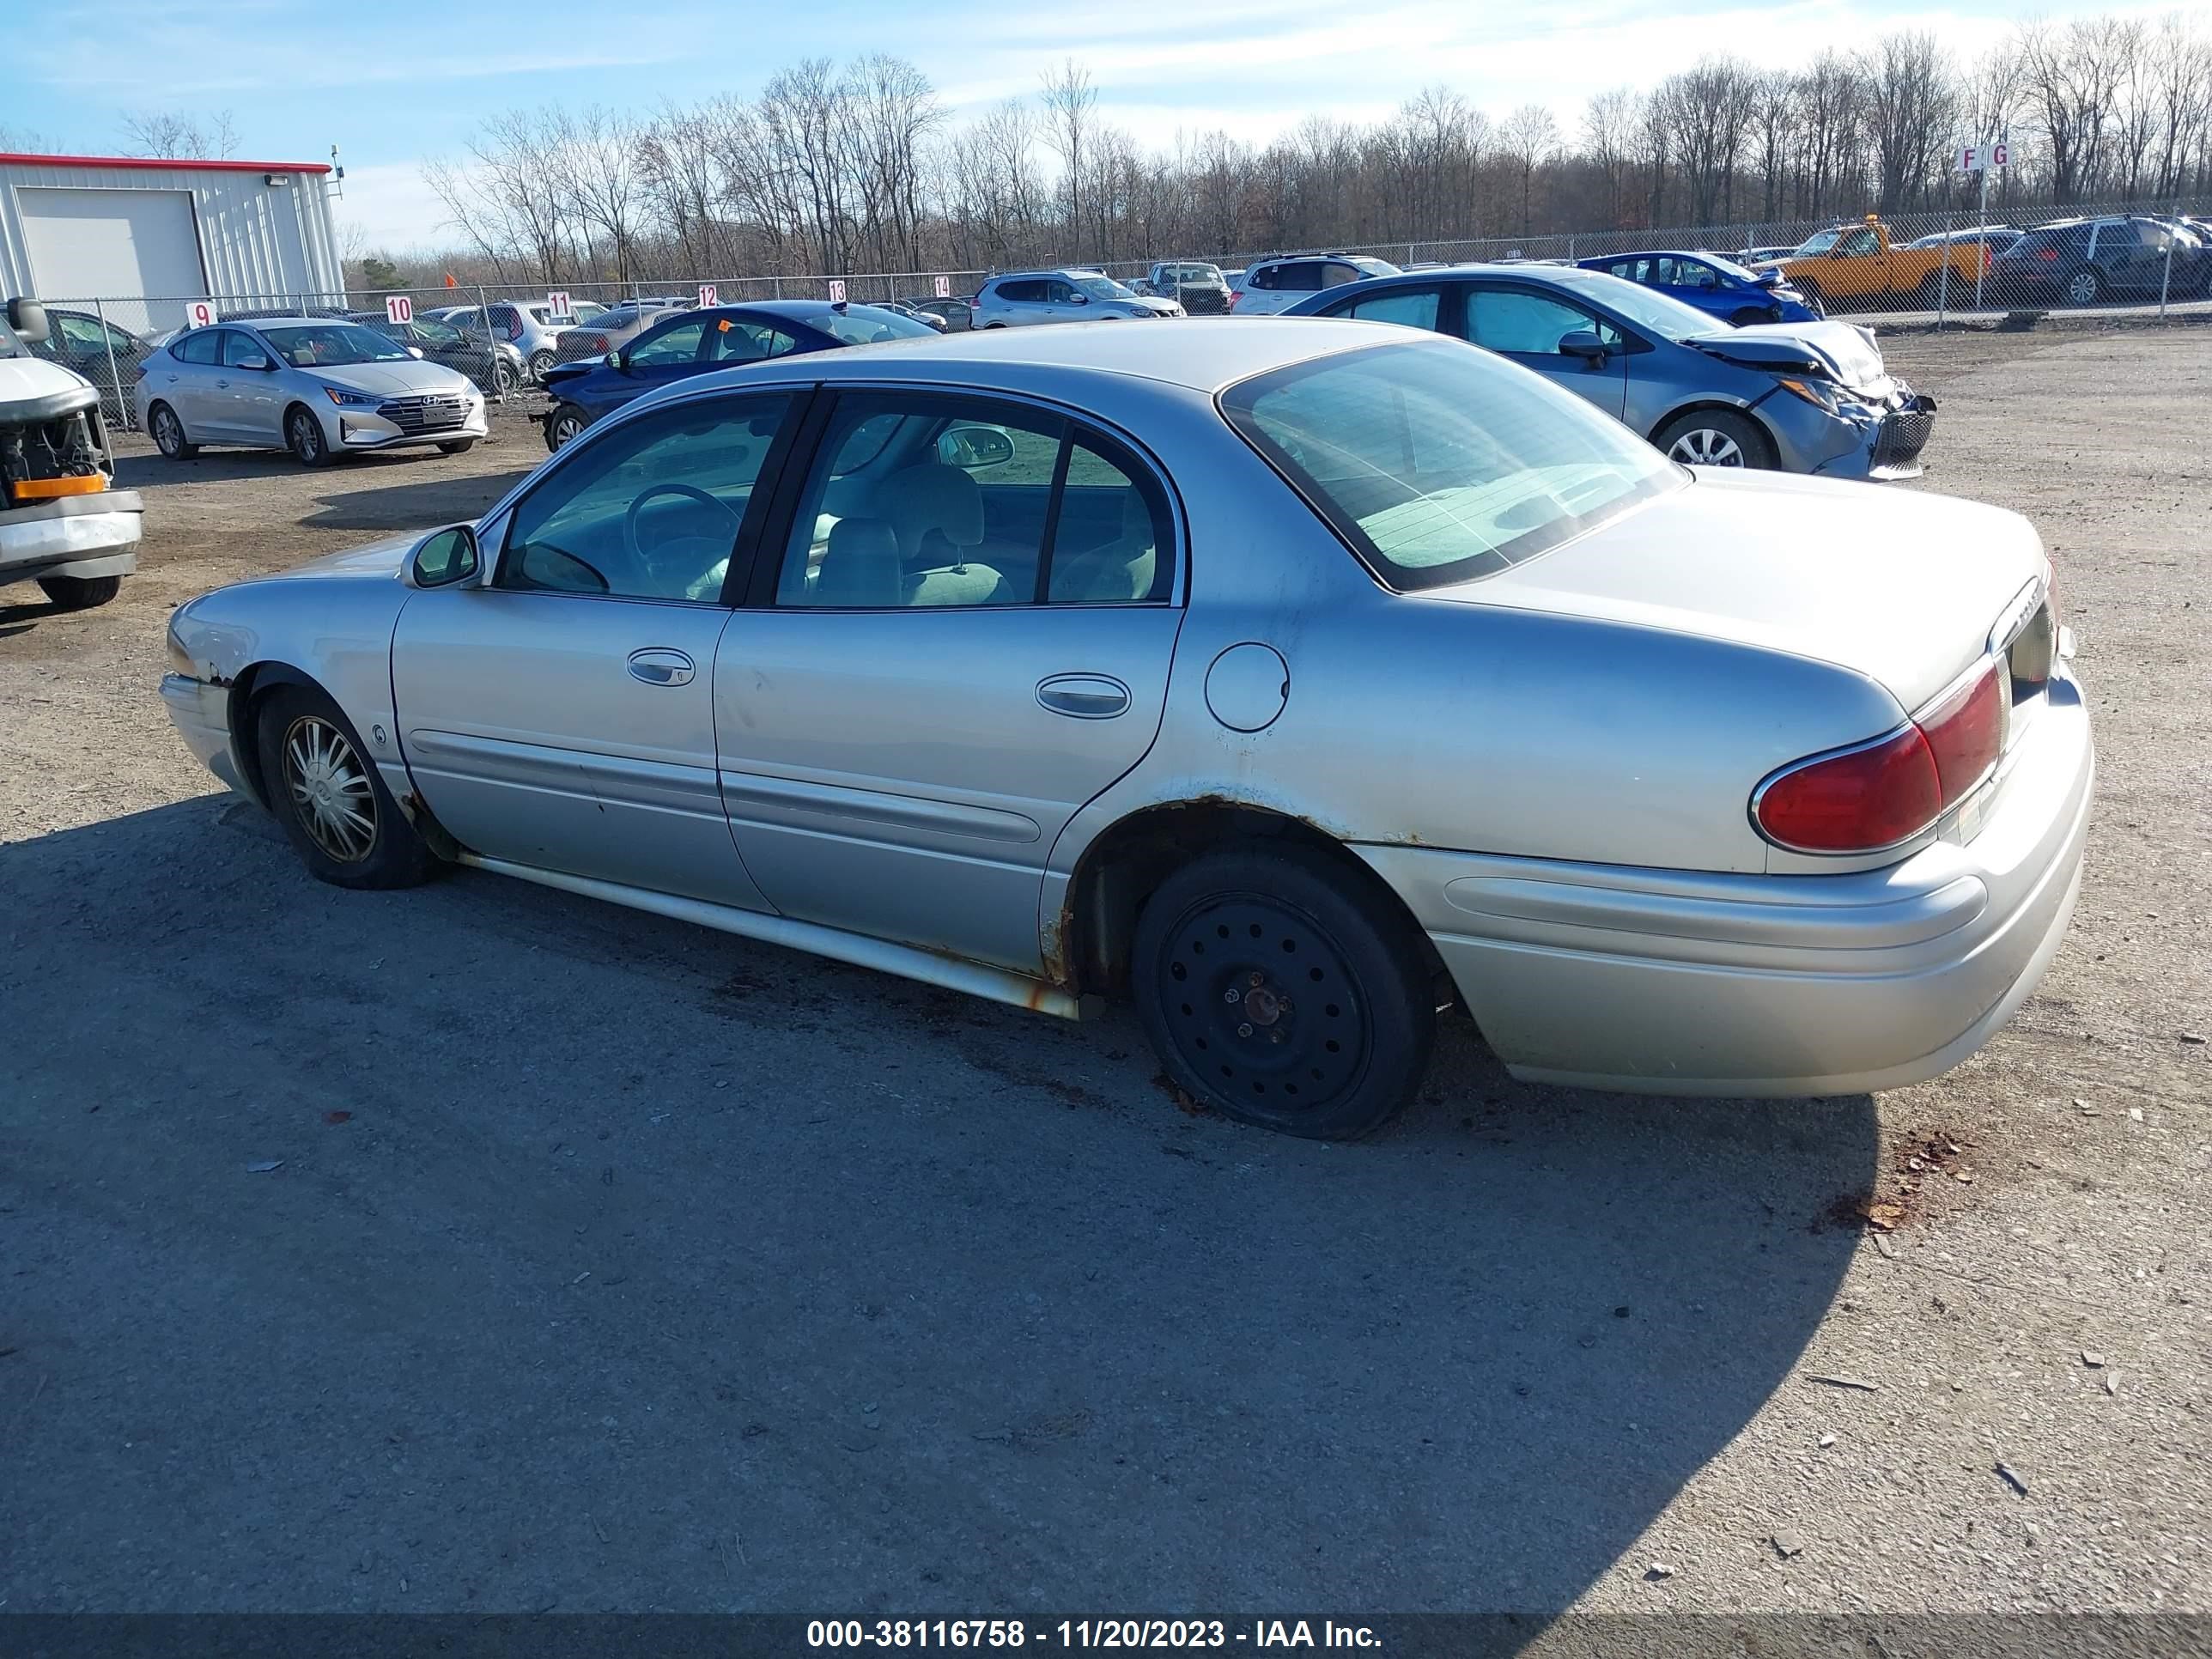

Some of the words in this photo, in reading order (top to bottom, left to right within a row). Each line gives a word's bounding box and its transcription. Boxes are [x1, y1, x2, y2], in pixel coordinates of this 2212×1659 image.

[1964, 149, 1976, 169] F
[1994, 144, 2008, 165] G
[830, 283, 845, 301] 13
[936, 277, 949, 296] 14
[550, 294, 568, 315] 11
[700, 287, 715, 307] 12
[195, 304, 210, 326] 9
[388, 298, 410, 322] 10
